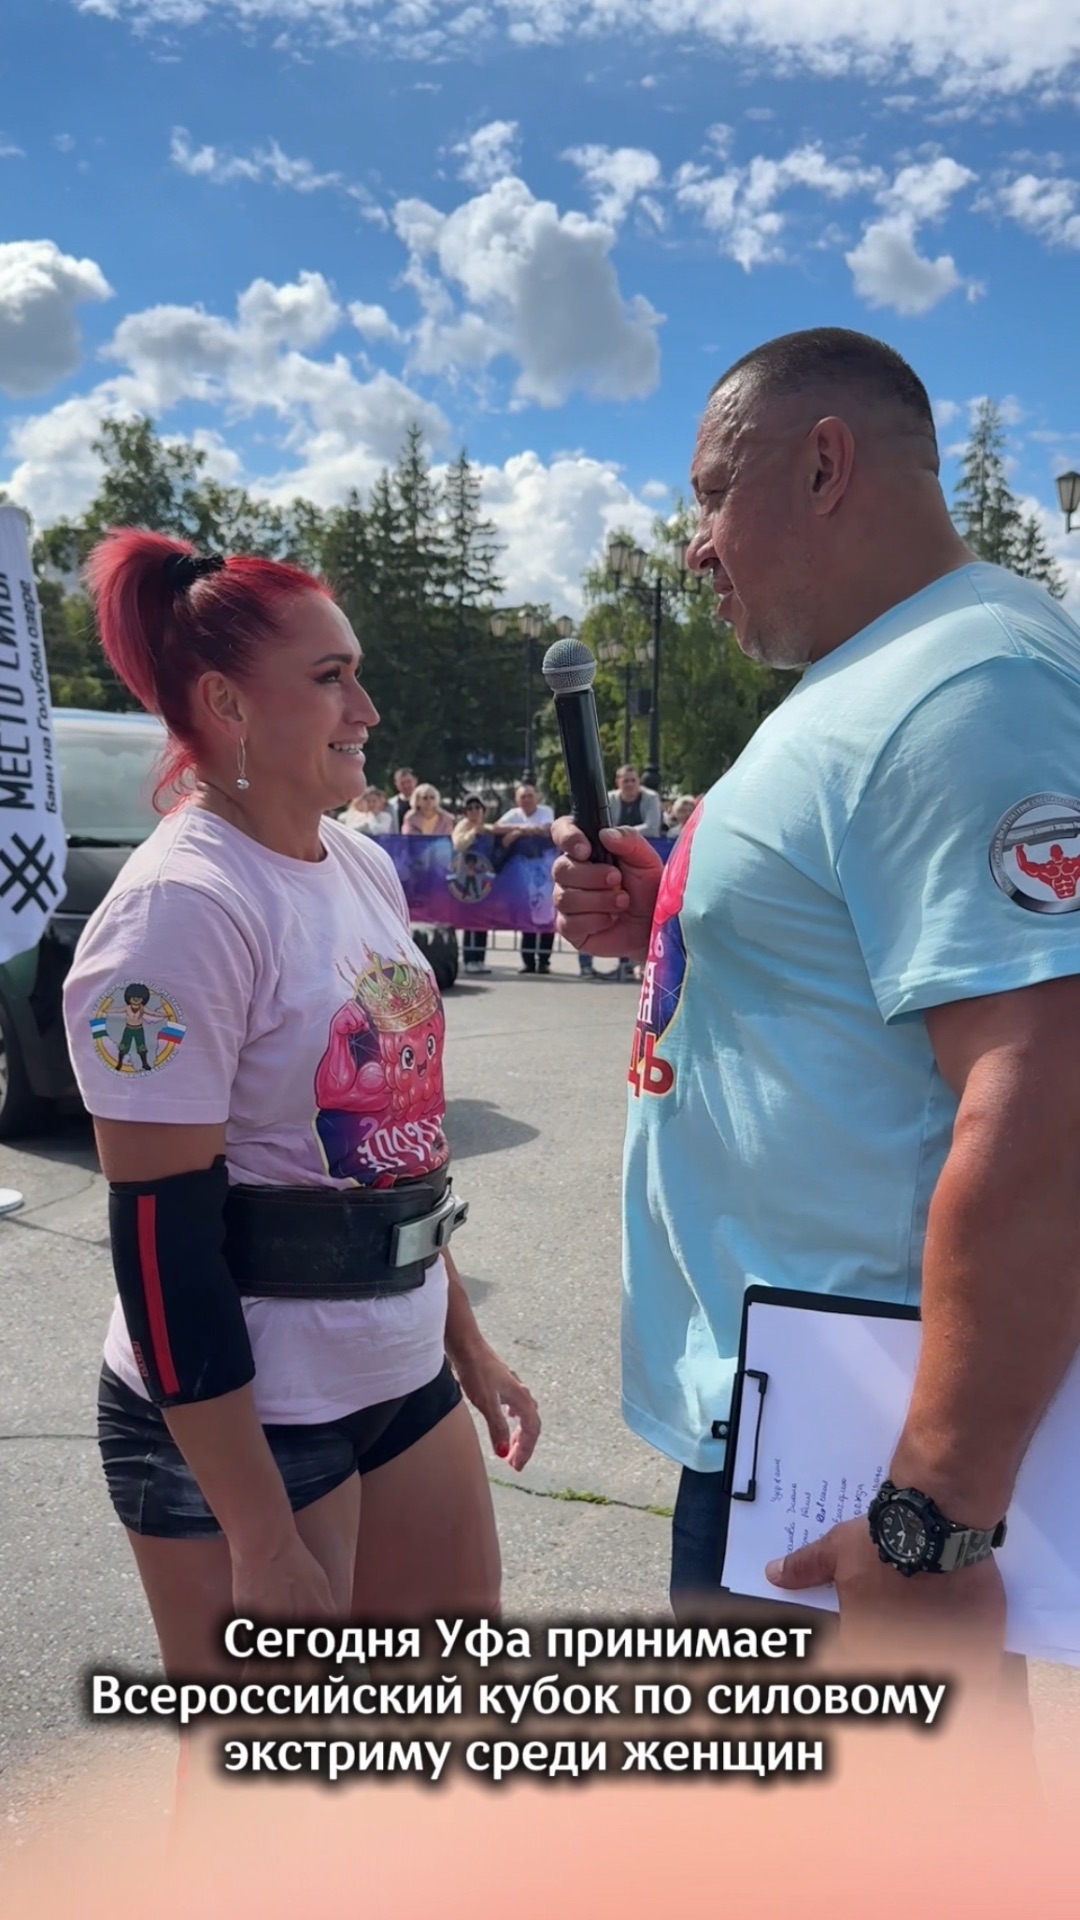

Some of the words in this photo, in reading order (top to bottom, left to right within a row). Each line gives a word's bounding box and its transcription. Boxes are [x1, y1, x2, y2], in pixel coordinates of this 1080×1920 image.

[20, 580, 38, 639] озере
[30, 641, 49, 731] Голубом
[0, 683, 36, 810] МЕСТО
[42, 737, 52, 760] на
[44, 764, 57, 814] Бани
